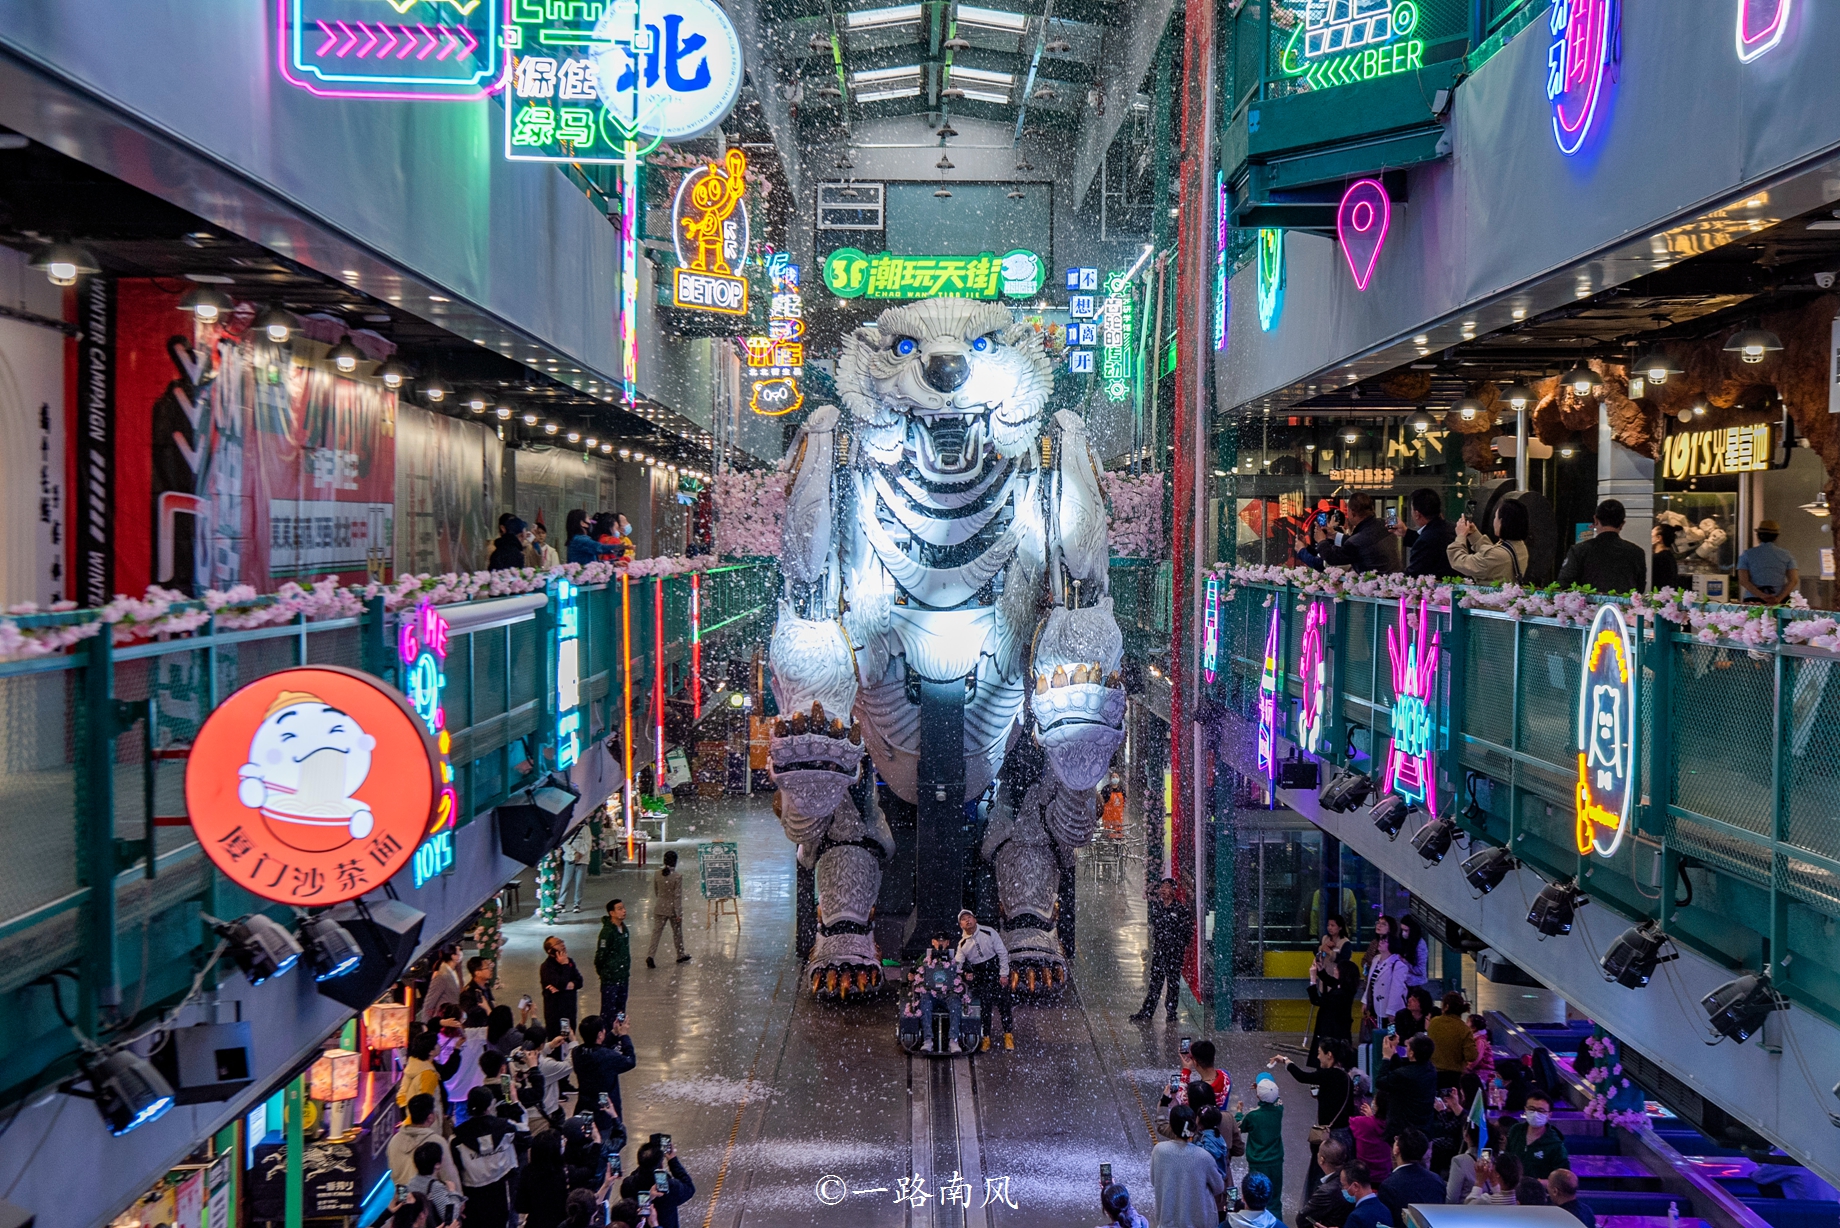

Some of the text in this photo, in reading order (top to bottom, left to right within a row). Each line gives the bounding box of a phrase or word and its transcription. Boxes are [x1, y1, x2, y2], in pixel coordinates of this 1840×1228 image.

[616, 13, 712, 93] 北
[1363, 40, 1423, 79] BEER
[511, 105, 596, 148] 绿马
[678, 273, 744, 310] BETOP
[867, 256, 1003, 296] 潮玩天街
[907, 291, 928, 299] WAN
[89, 277, 107, 441] WINTER CAMPAIGN
[1103, 296, 1124, 378] 齿轮的传动
[87, 550, 106, 609] WINTE
[402, 605, 450, 663] GME
[216, 825, 403, 899] 厦门沙茶面
